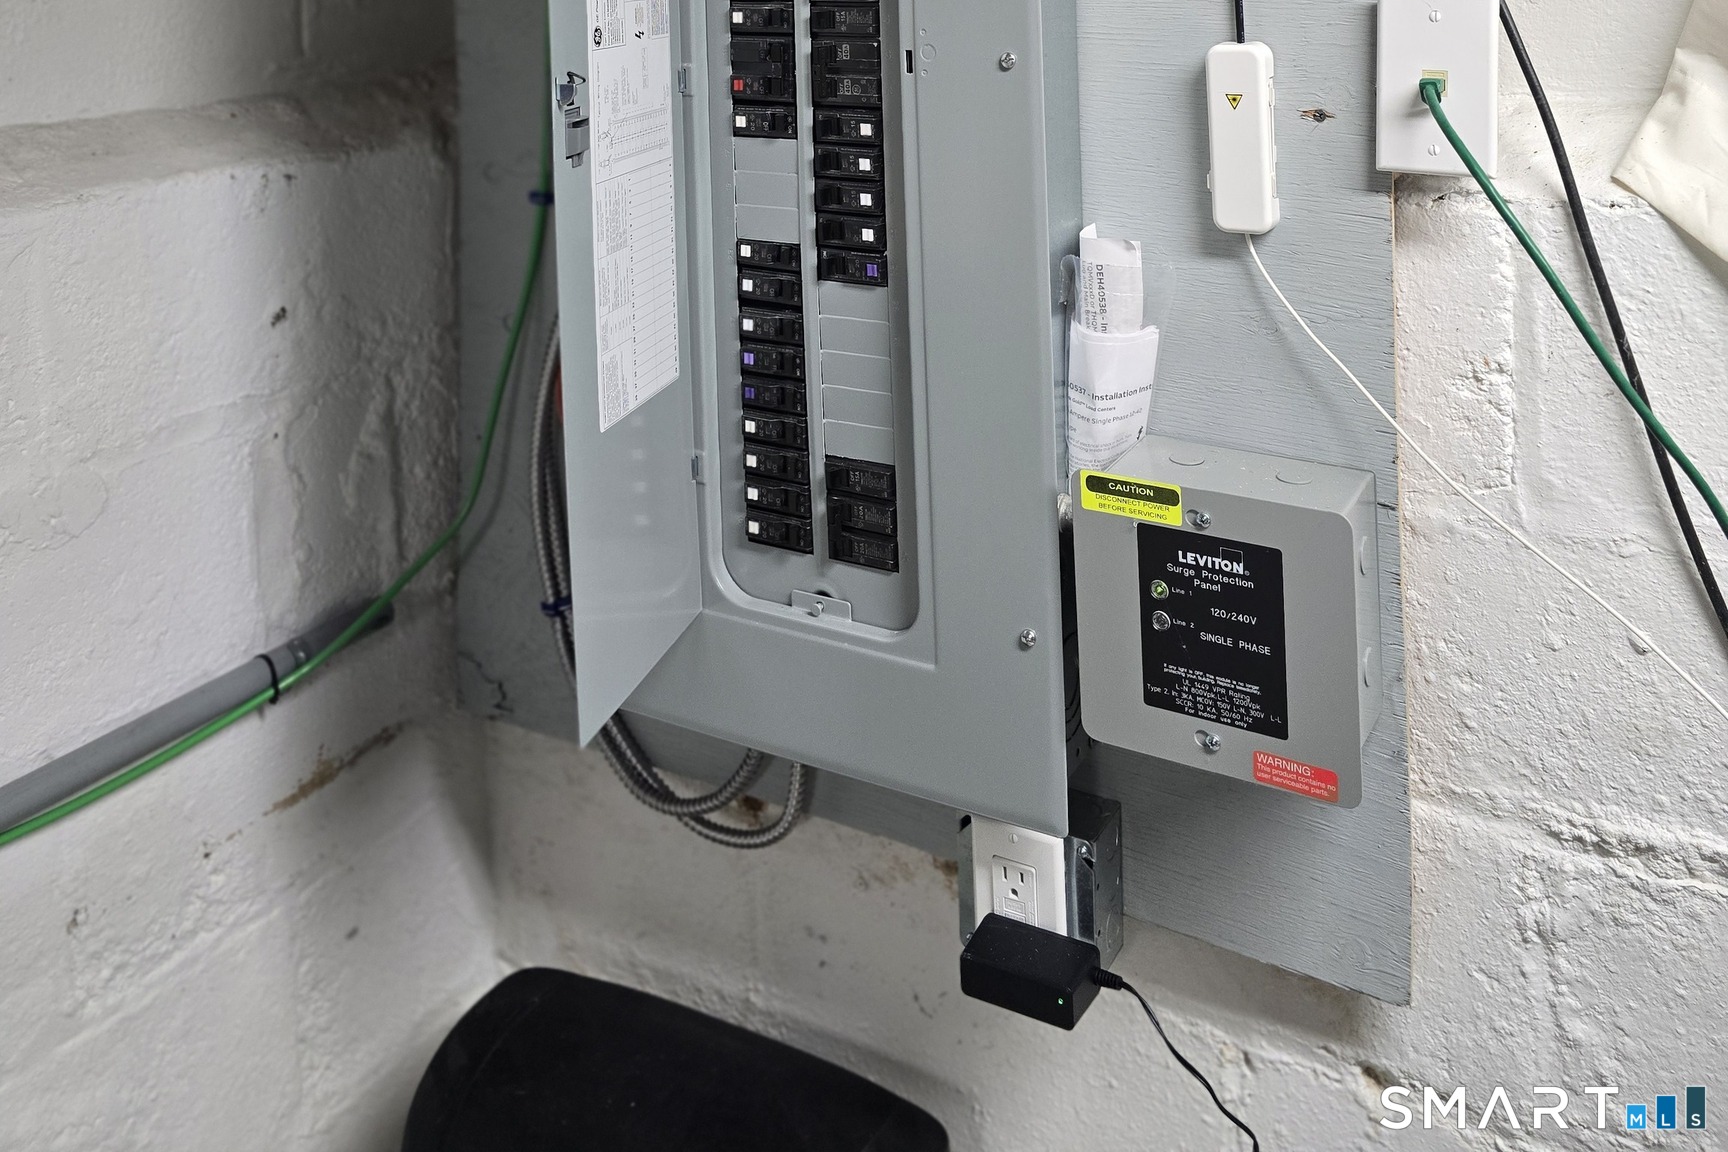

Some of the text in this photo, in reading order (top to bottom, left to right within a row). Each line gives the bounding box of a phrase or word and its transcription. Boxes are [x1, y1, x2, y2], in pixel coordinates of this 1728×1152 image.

[1096, 264, 1107, 315] DEH40538
[1100, 323, 1108, 334] In
[1091, 389, 1138, 401] Installation
[1138, 383, 1152, 394] Inst
[1069, 409, 1091, 423] Ampere
[1112, 413, 1129, 422] Phase
[1108, 482, 1154, 497] CAUTION
[1095, 493, 1170, 512] DISCONNECT POWER
[1098, 503, 1168, 520] BEFORE SERVICING
[1178, 550, 1244, 575] LEVITON
[1166, 563, 1254, 589] Surge Protection
[1193, 578, 1221, 592] Panel
[1171, 586, 1185, 595] Line
[1172, 618, 1186, 627] Line
[1210, 608, 1257, 625] 120/240V
[1200, 632, 1271, 656] SINGLE PHASE
[1175, 683, 1189, 692] L-N
[1182, 678, 1191, 686] UL
[1194, 681, 1210, 691] 1449
[1212, 686, 1226, 695] VPR
[1146, 683, 1162, 694] Type
[1217, 701, 1231, 710] 150V
[1249, 709, 1265, 719] 300V
[1270, 714, 1282, 724] L-L
[1175, 698, 1194, 708] SCCR:
[1196, 703, 1204, 711] 10
[1220, 709, 1241, 720] 50/60
[1243, 715, 1253, 724] Hz
[1184, 706, 1195, 714] For
[1234, 720, 1248, 728] only
[1256, 752, 1315, 778] WARNING:
[1256, 763, 1336, 792] This product contains no
[1256, 771, 1331, 797] user serviceable parts.
